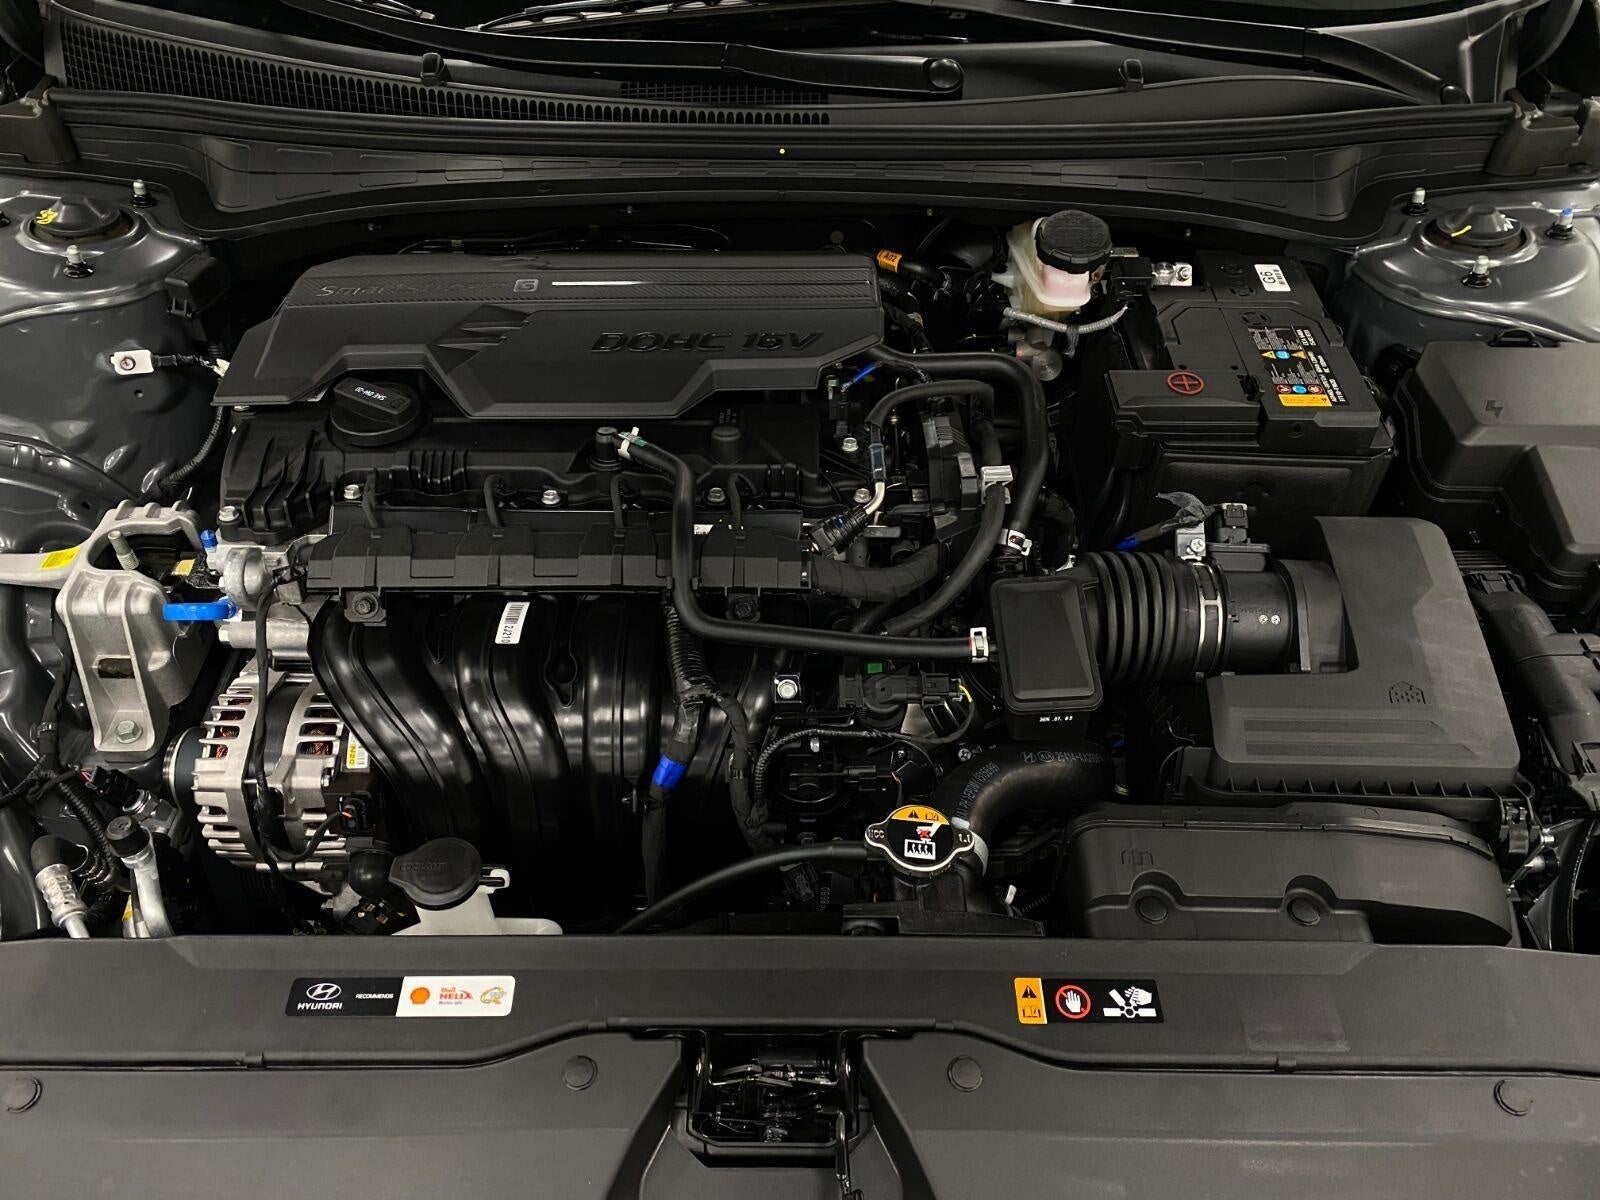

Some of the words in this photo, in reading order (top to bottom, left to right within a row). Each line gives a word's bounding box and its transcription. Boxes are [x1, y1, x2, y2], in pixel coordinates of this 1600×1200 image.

[591, 331, 733, 353] DOHC
[742, 331, 824, 352] 16V
[354, 386, 374, 397] 0W-20
[374, 393, 387, 401] SAE
[439, 992, 472, 1000] HELIX
[297, 1002, 343, 1010] HYUNDAI
